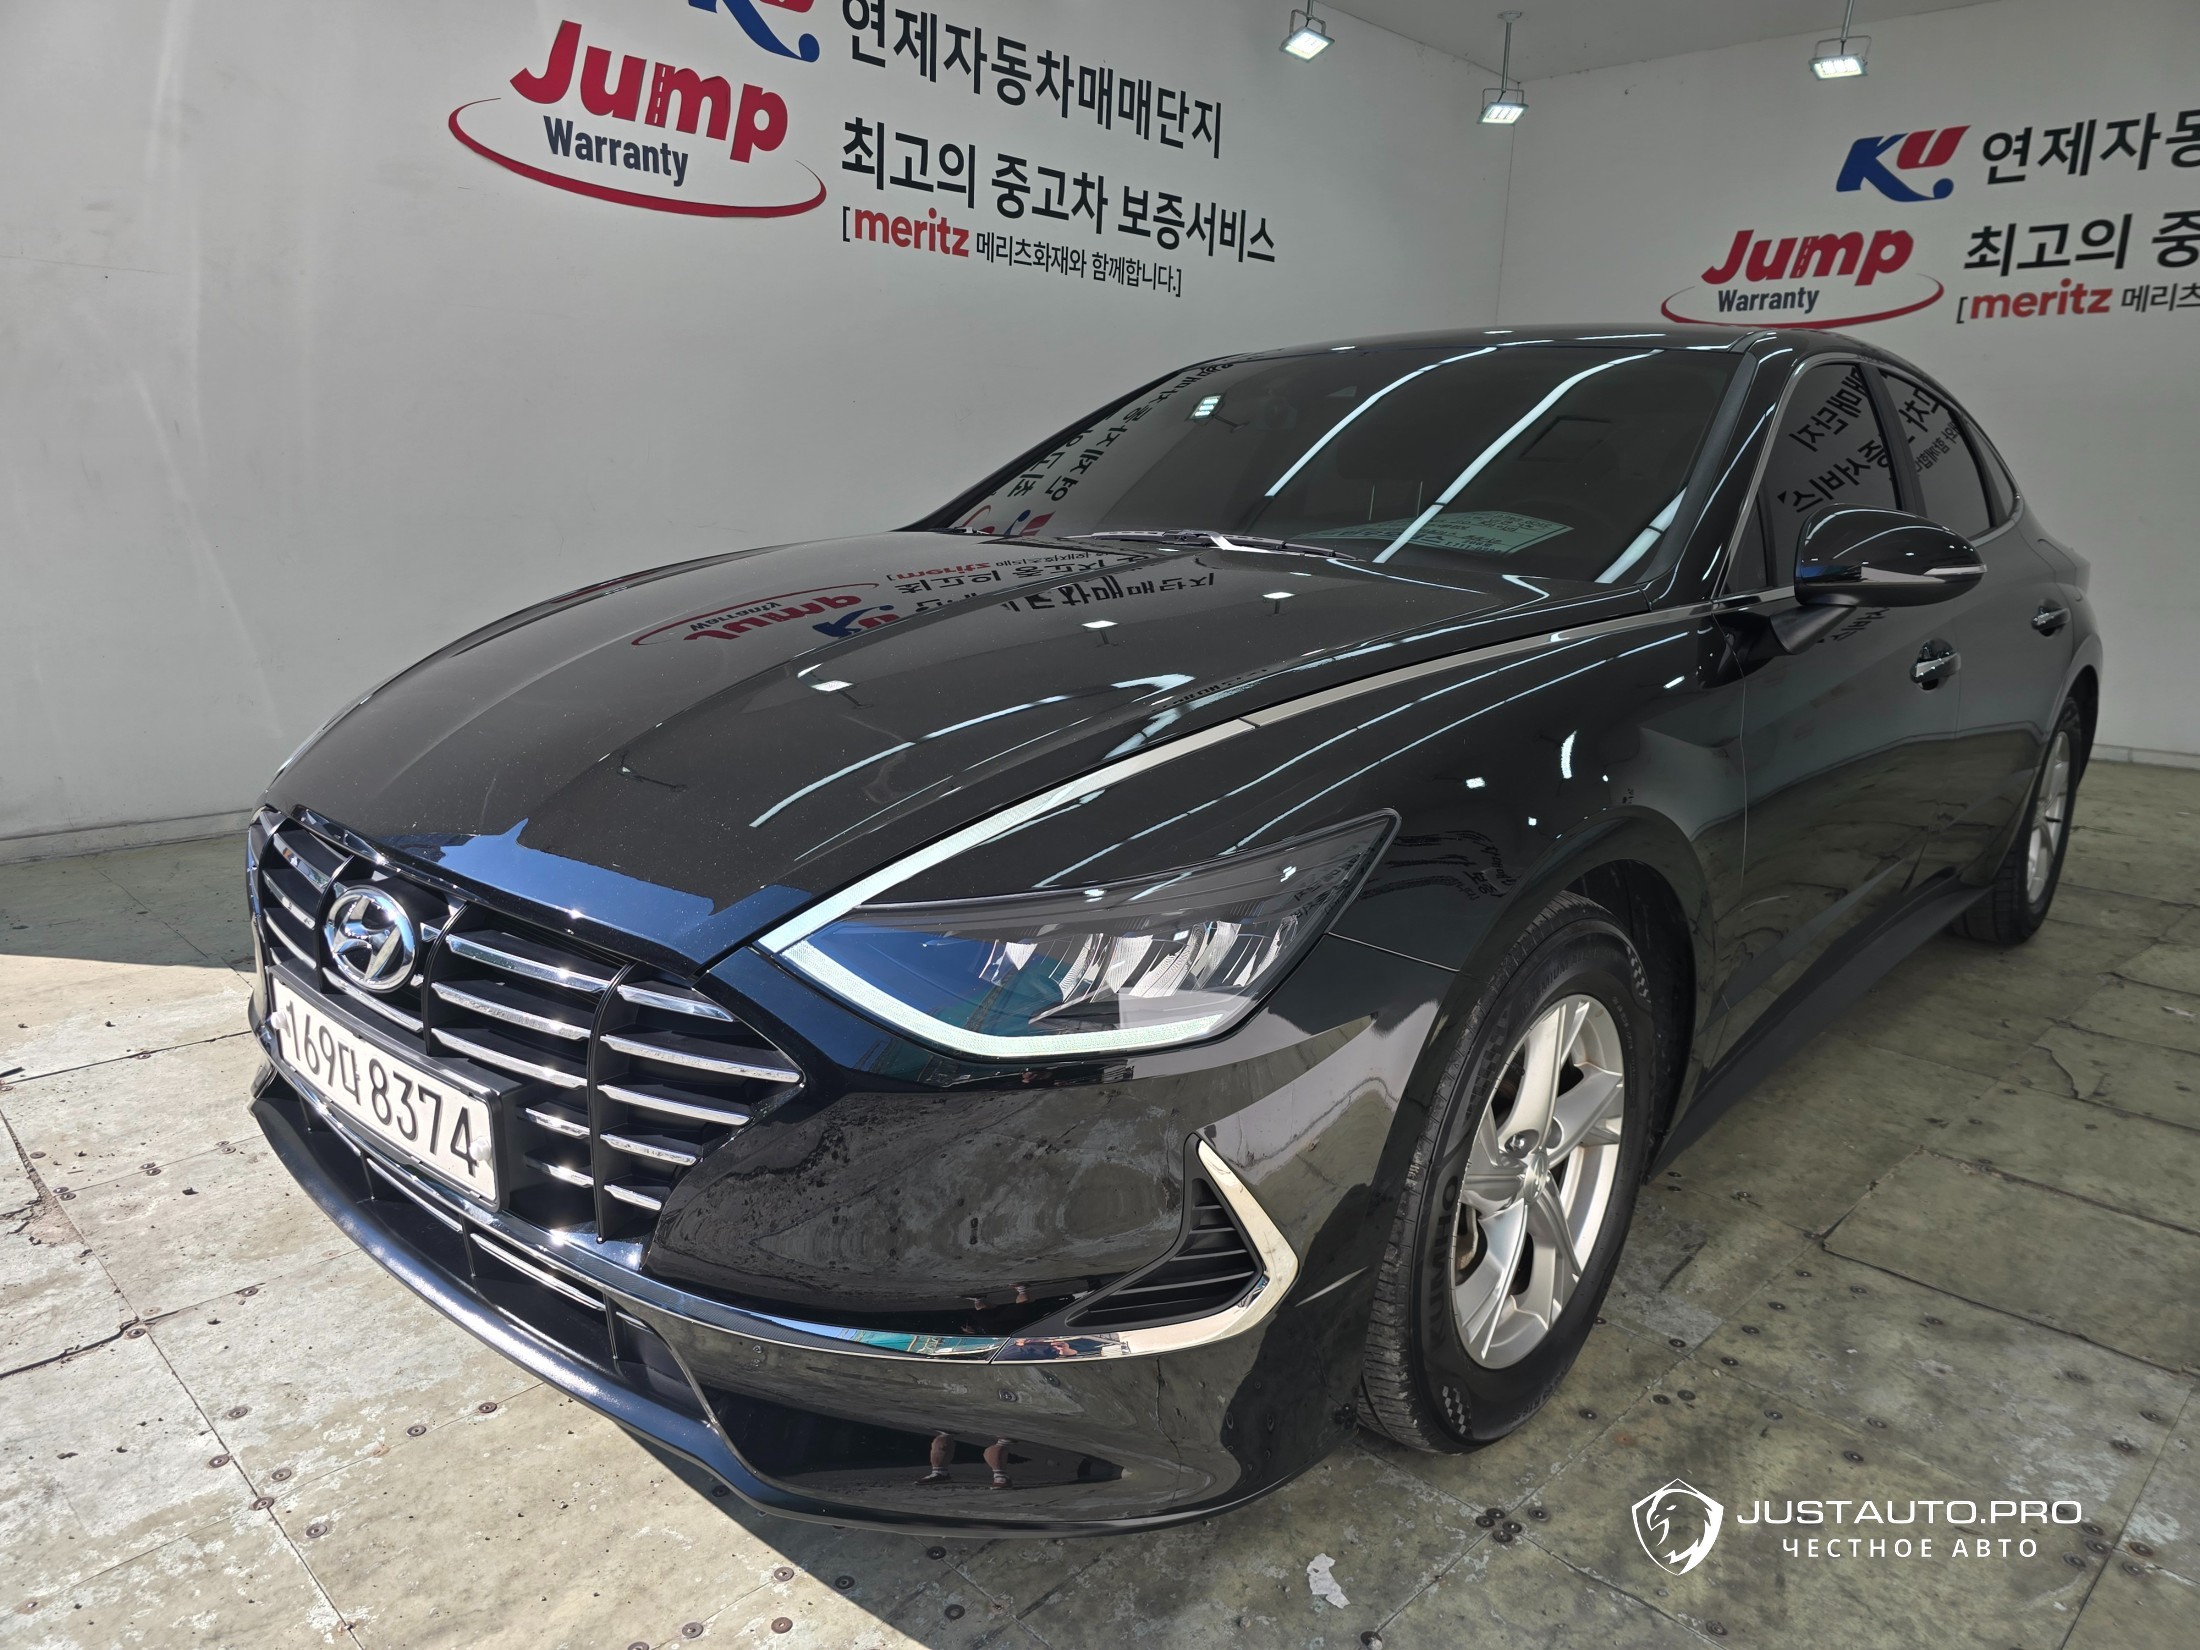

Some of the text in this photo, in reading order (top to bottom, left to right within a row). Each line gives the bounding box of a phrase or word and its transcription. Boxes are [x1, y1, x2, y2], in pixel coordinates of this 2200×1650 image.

[510, 20, 788, 163] Jump
[842, 0, 1222, 159] 연제자동차매매단지
[543, 115, 689, 188] Warranty
[842, 117, 1276, 263] 최고의 중고차 보증서비스
[976, 231, 1087, 278] 메리츠화재와
[1701, 229, 1915, 286] Jump
[1963, 213, 2133, 277] 최고의
[1717, 286, 1820, 314] Warranty
[368, 1057, 479, 1178] 8374
[1429, 1175, 1458, 1349] KUMHO
